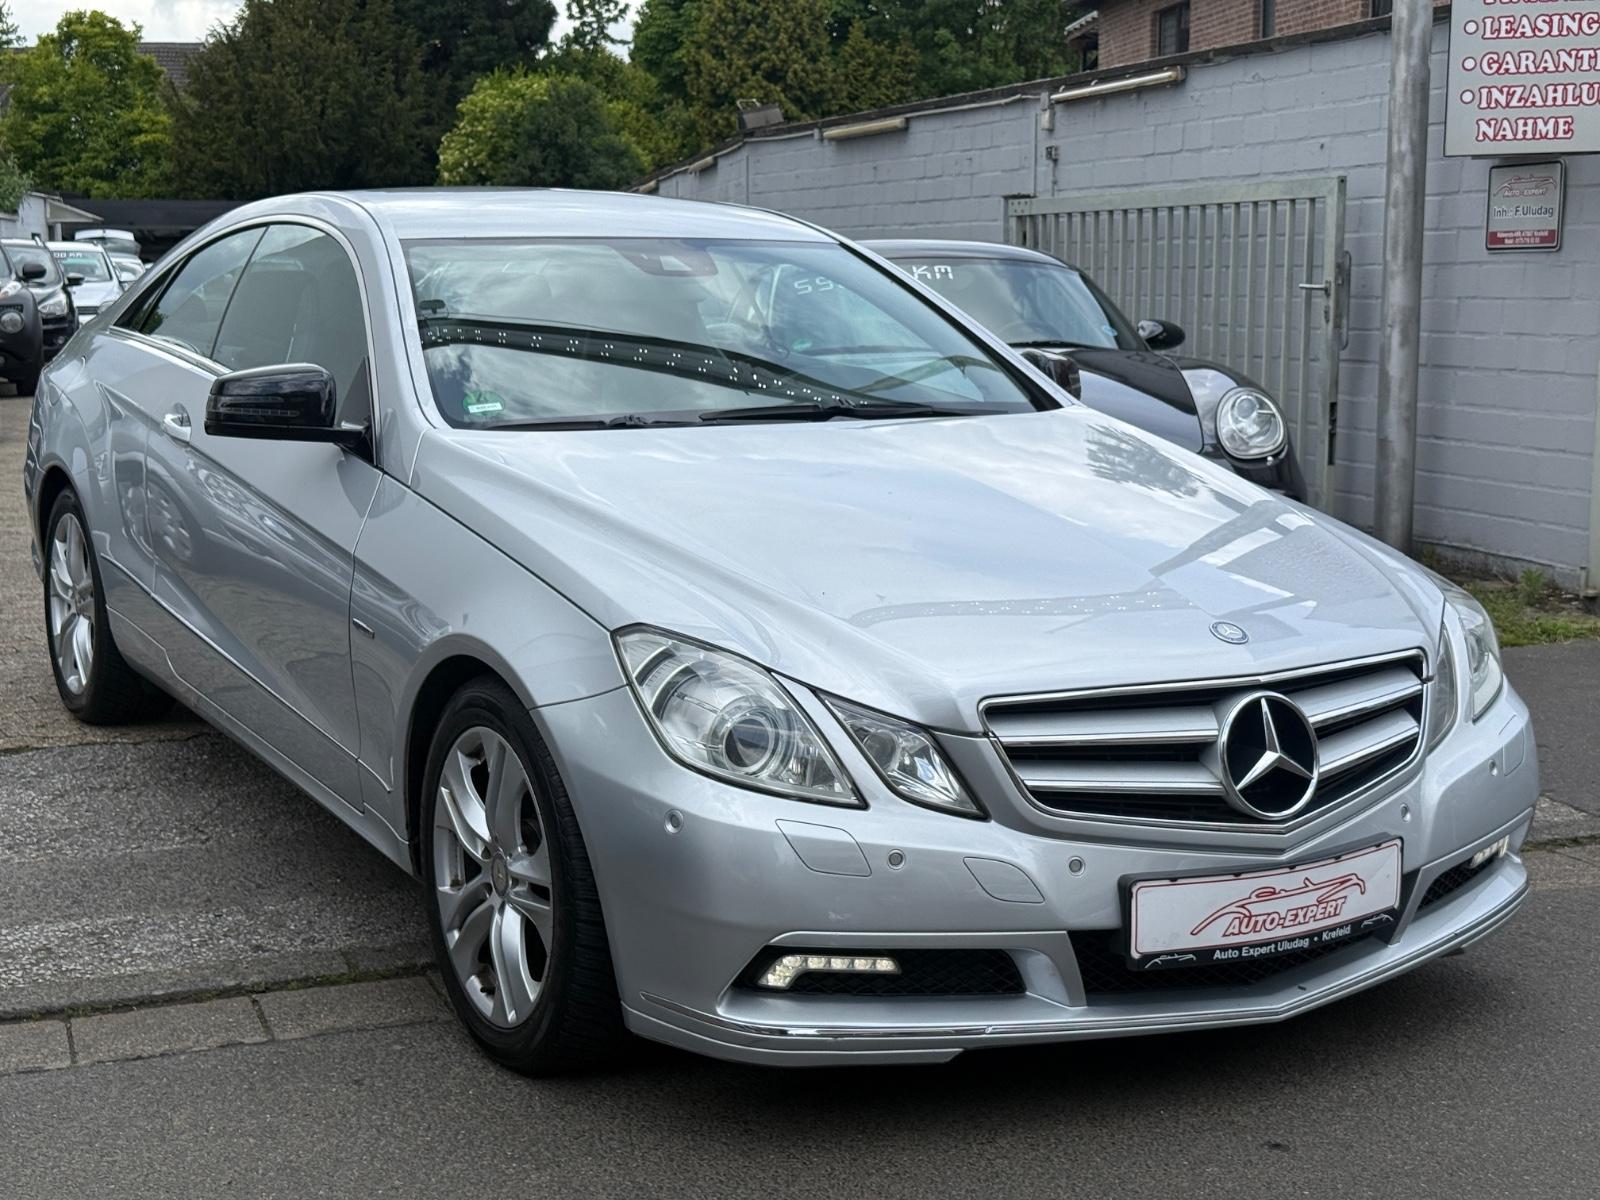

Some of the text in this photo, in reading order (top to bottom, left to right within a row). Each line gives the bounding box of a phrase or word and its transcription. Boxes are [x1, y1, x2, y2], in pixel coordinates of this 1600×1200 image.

[1482, 11, 1600, 40] LEASING
[1475, 115, 1574, 142] NAHME
[1222, 896, 1347, 938] AUTO-EXPERT
[1213, 925, 1351, 960] Auto Expert Uludag Krefeld
